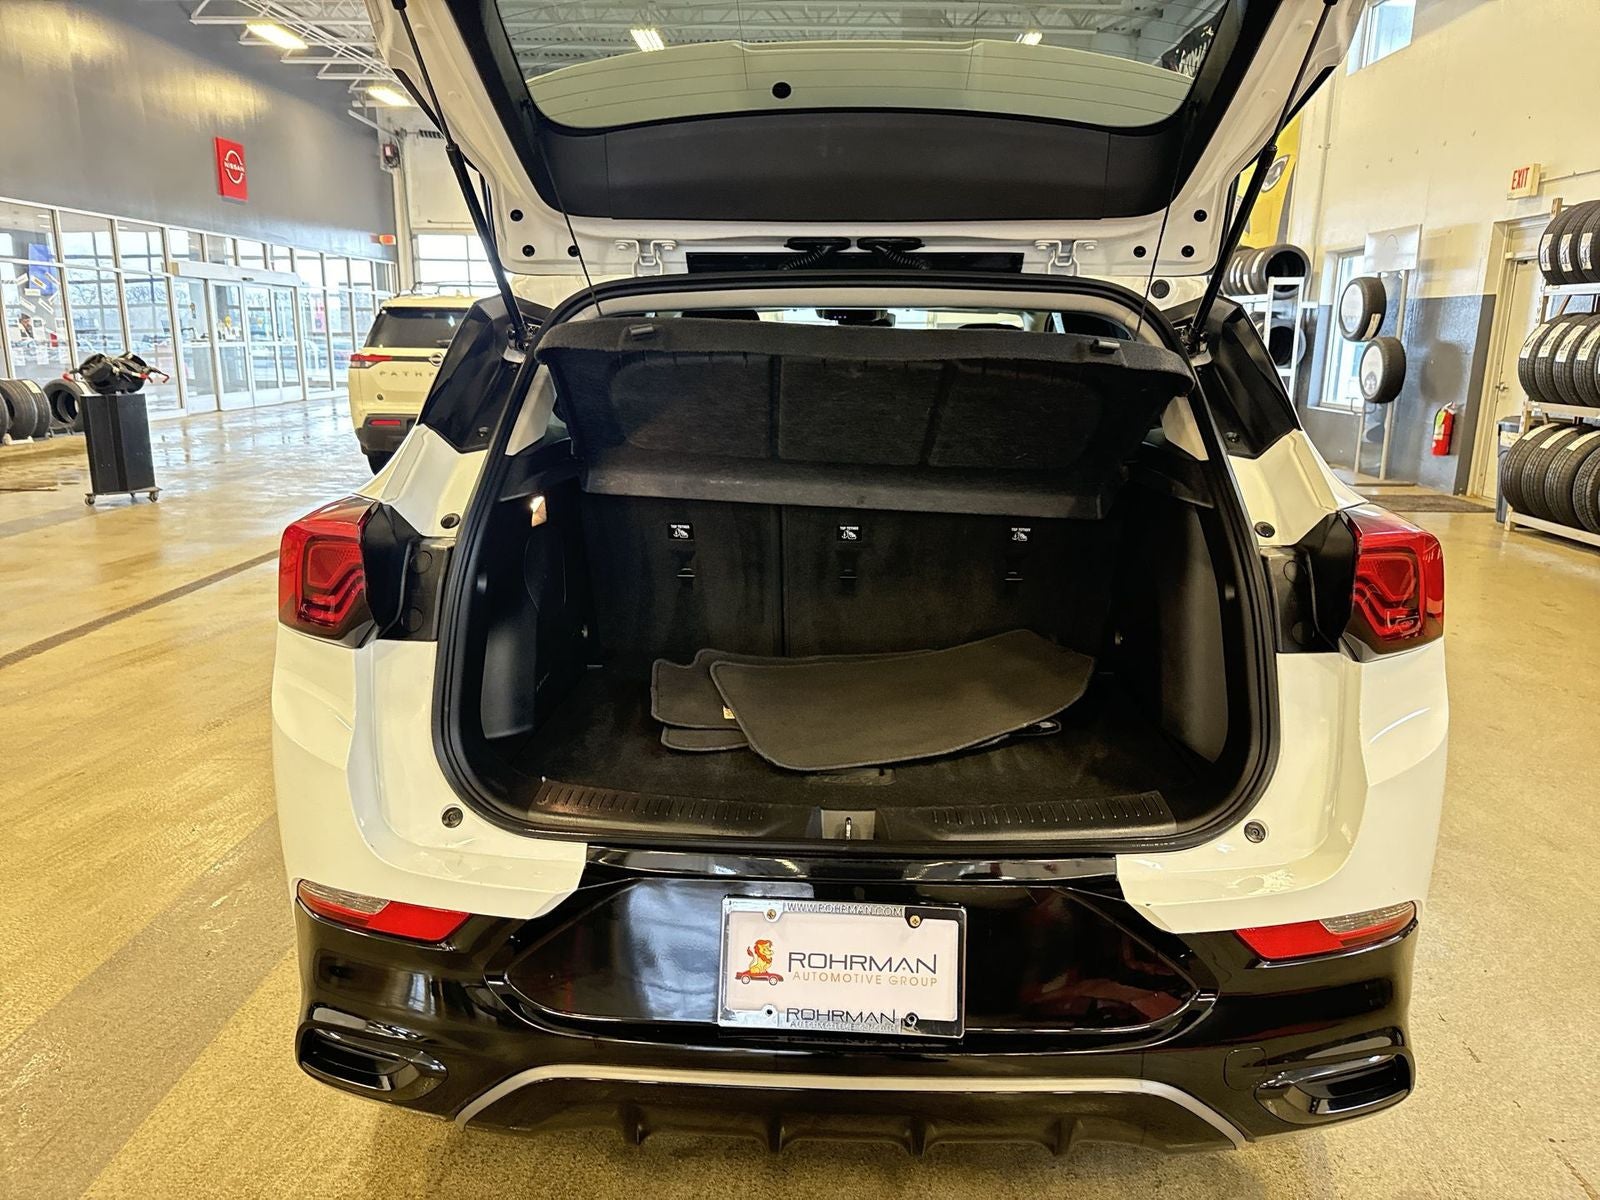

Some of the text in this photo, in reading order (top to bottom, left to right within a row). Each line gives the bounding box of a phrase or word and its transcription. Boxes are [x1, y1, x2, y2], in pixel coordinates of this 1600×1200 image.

[1511, 167, 1530, 190] EXIT
[787, 902, 903, 917] WWW.ROHRMAN.COM
[788, 952, 937, 975] ROHRMAN
[792, 971, 938, 987] AUTOMOTIVE GROUP
[786, 1007, 896, 1024] ROHRMAN
